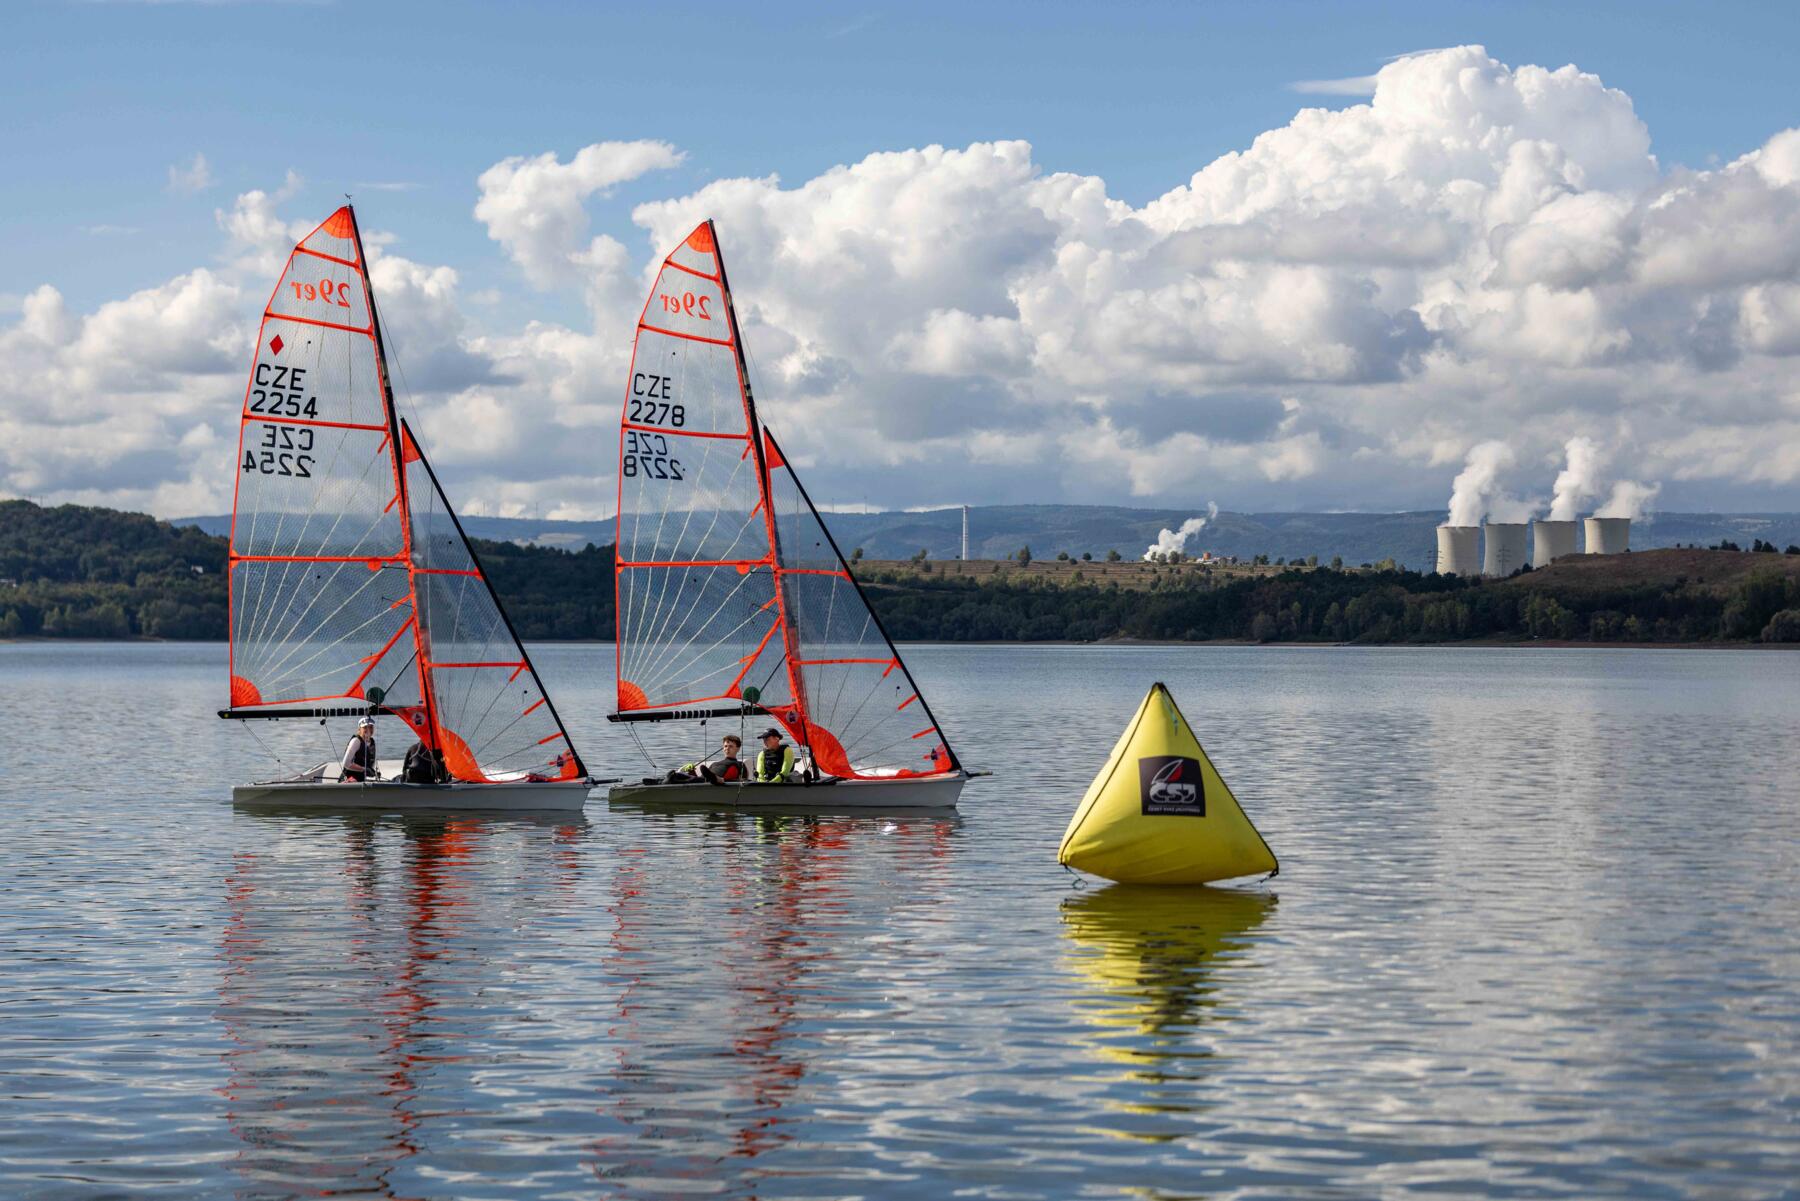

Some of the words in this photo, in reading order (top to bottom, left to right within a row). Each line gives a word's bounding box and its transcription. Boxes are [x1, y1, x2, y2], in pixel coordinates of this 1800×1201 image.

[255, 363, 306, 391] CZE
[633, 373, 671, 399] CZE
[250, 389, 318, 419] 2254
[629, 400, 685, 427] 2278
